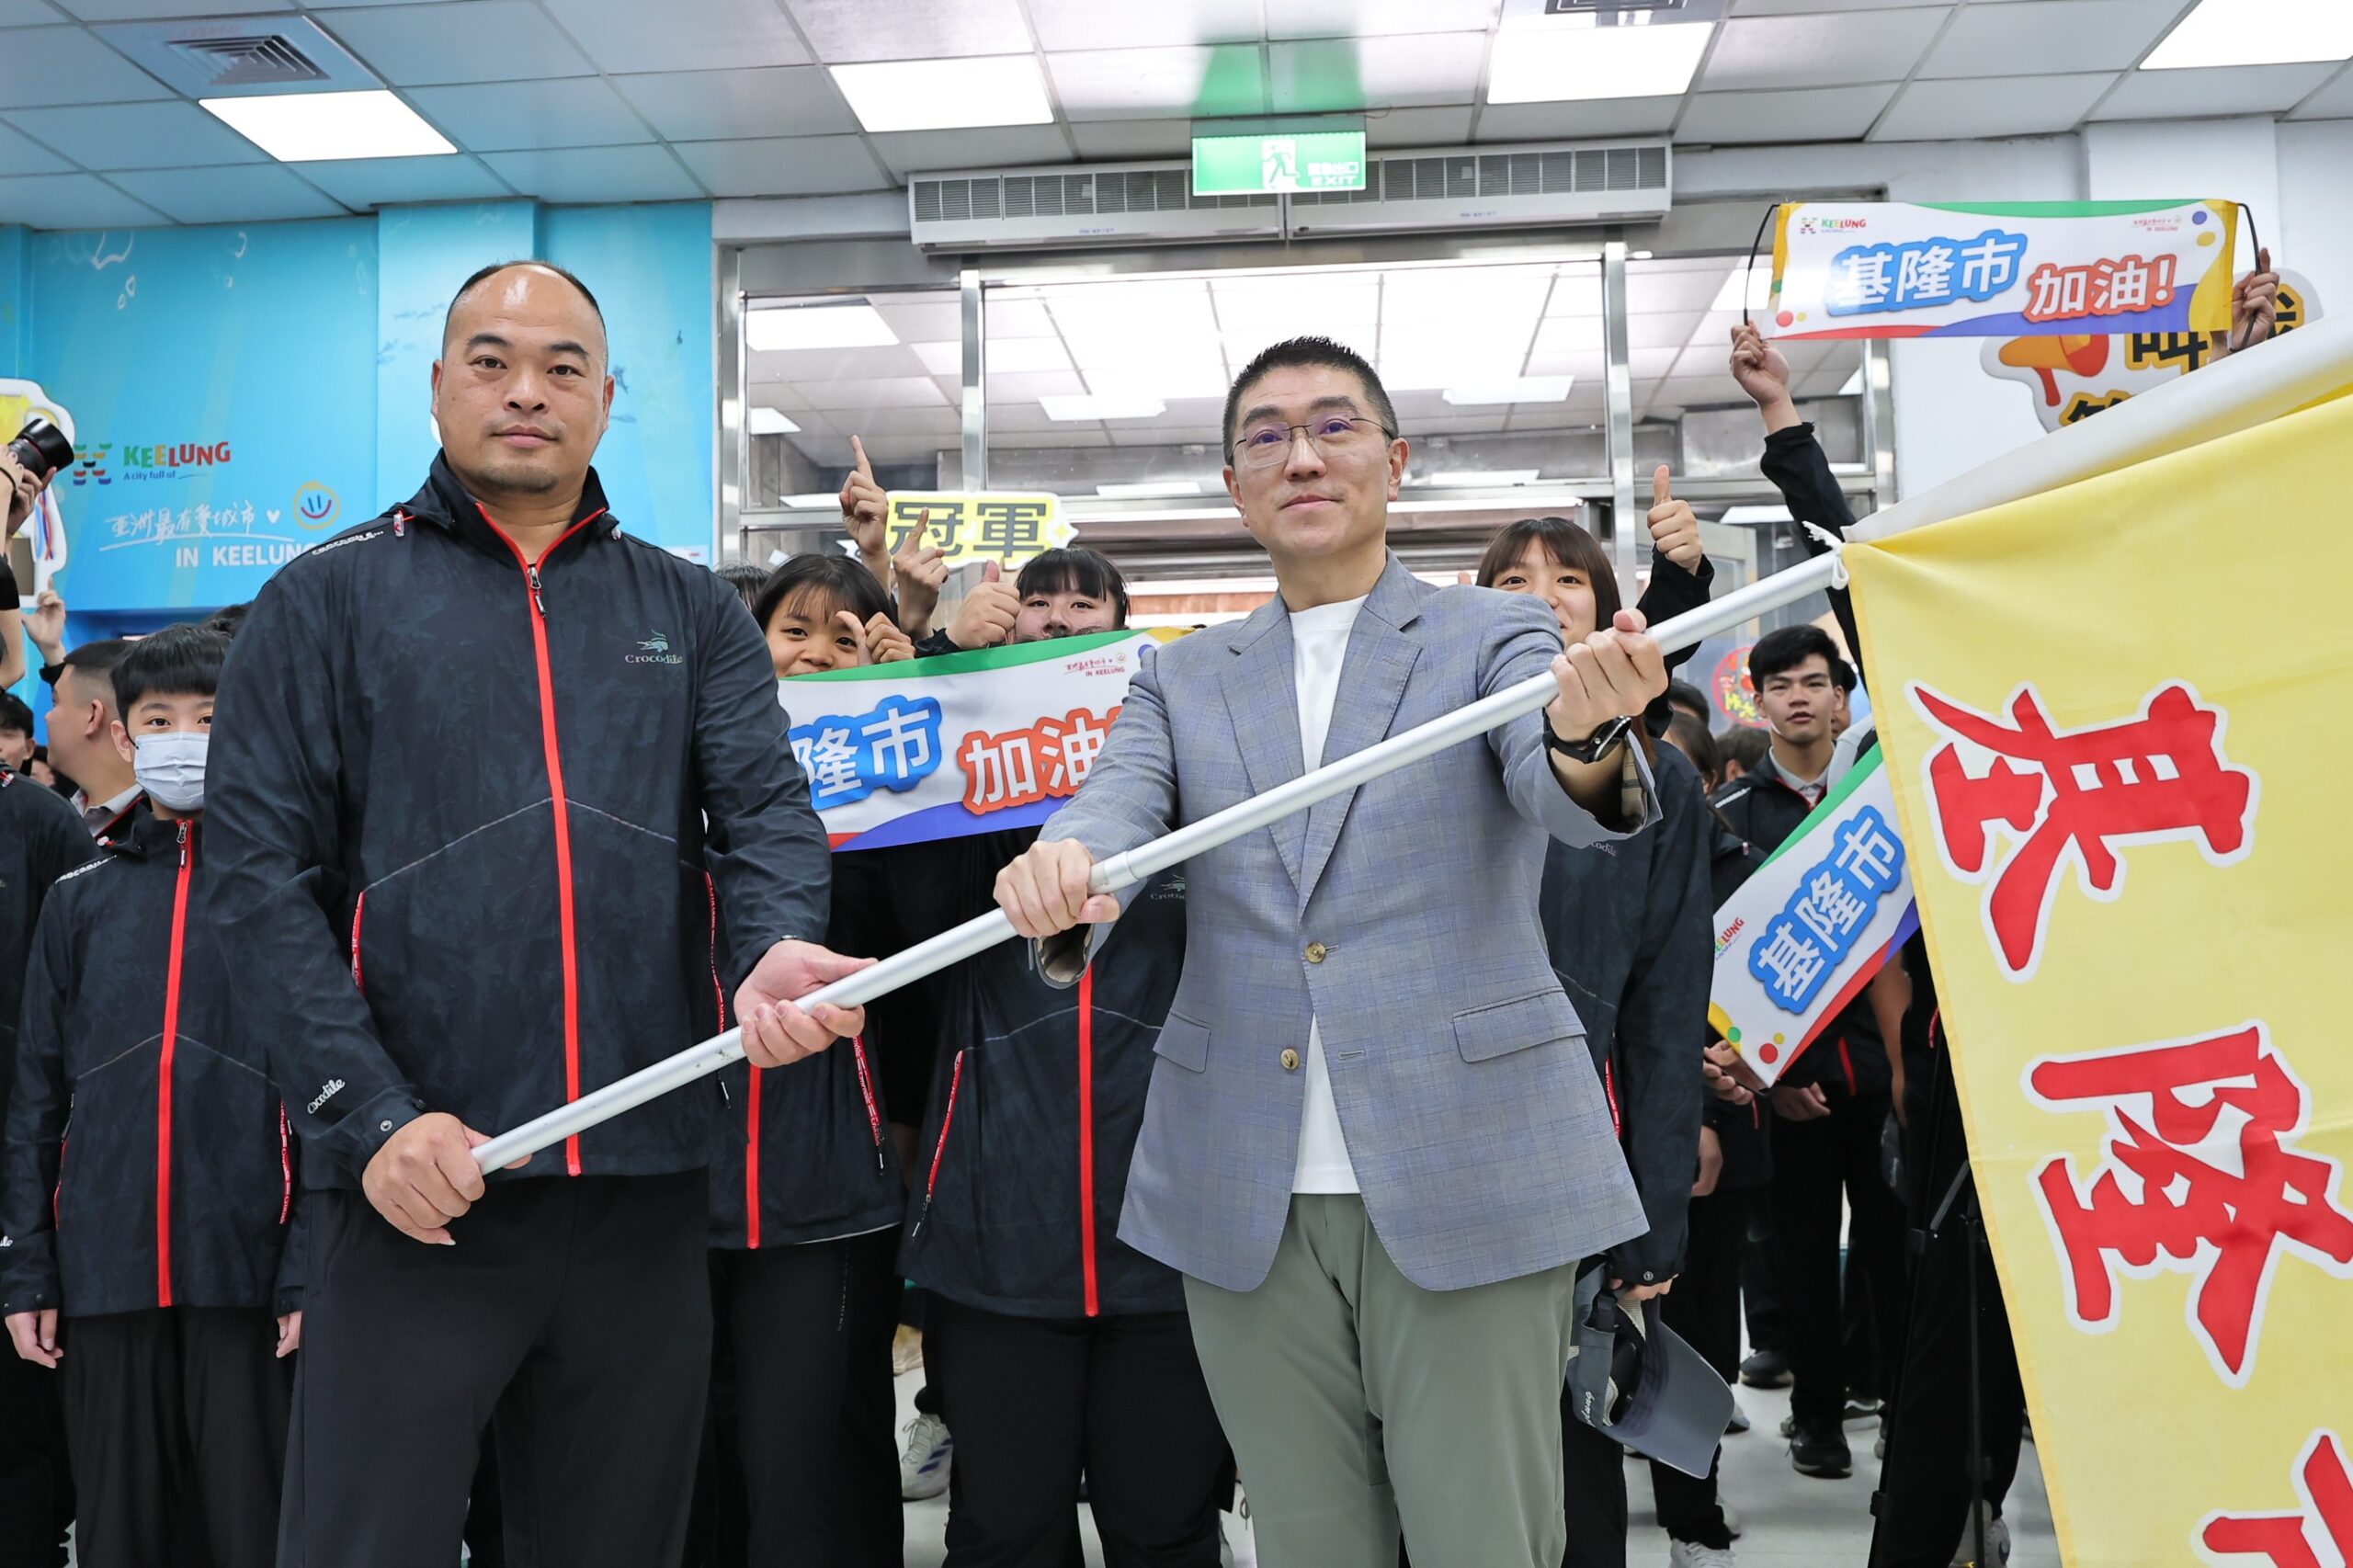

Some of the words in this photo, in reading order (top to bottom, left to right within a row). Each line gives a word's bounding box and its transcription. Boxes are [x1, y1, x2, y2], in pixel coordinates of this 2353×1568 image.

[1310, 176, 1358, 187] EXIT
[1821, 219, 1867, 229] KEELUNG
[1837, 238, 2018, 306] 基隆市
[123, 441, 232, 469] KEELUNG
[132, 471, 147, 482] city
[149, 471, 165, 480] full
[166, 470, 176, 479] of
[890, 502, 1048, 559] 冠軍
[176, 547, 199, 568] IN
[1096, 666, 1125, 676] KEELUNG
[965, 716, 1107, 807] 加油
[1756, 816, 1901, 1002] 基隆市
[1714, 916, 1745, 952] EELUNG
